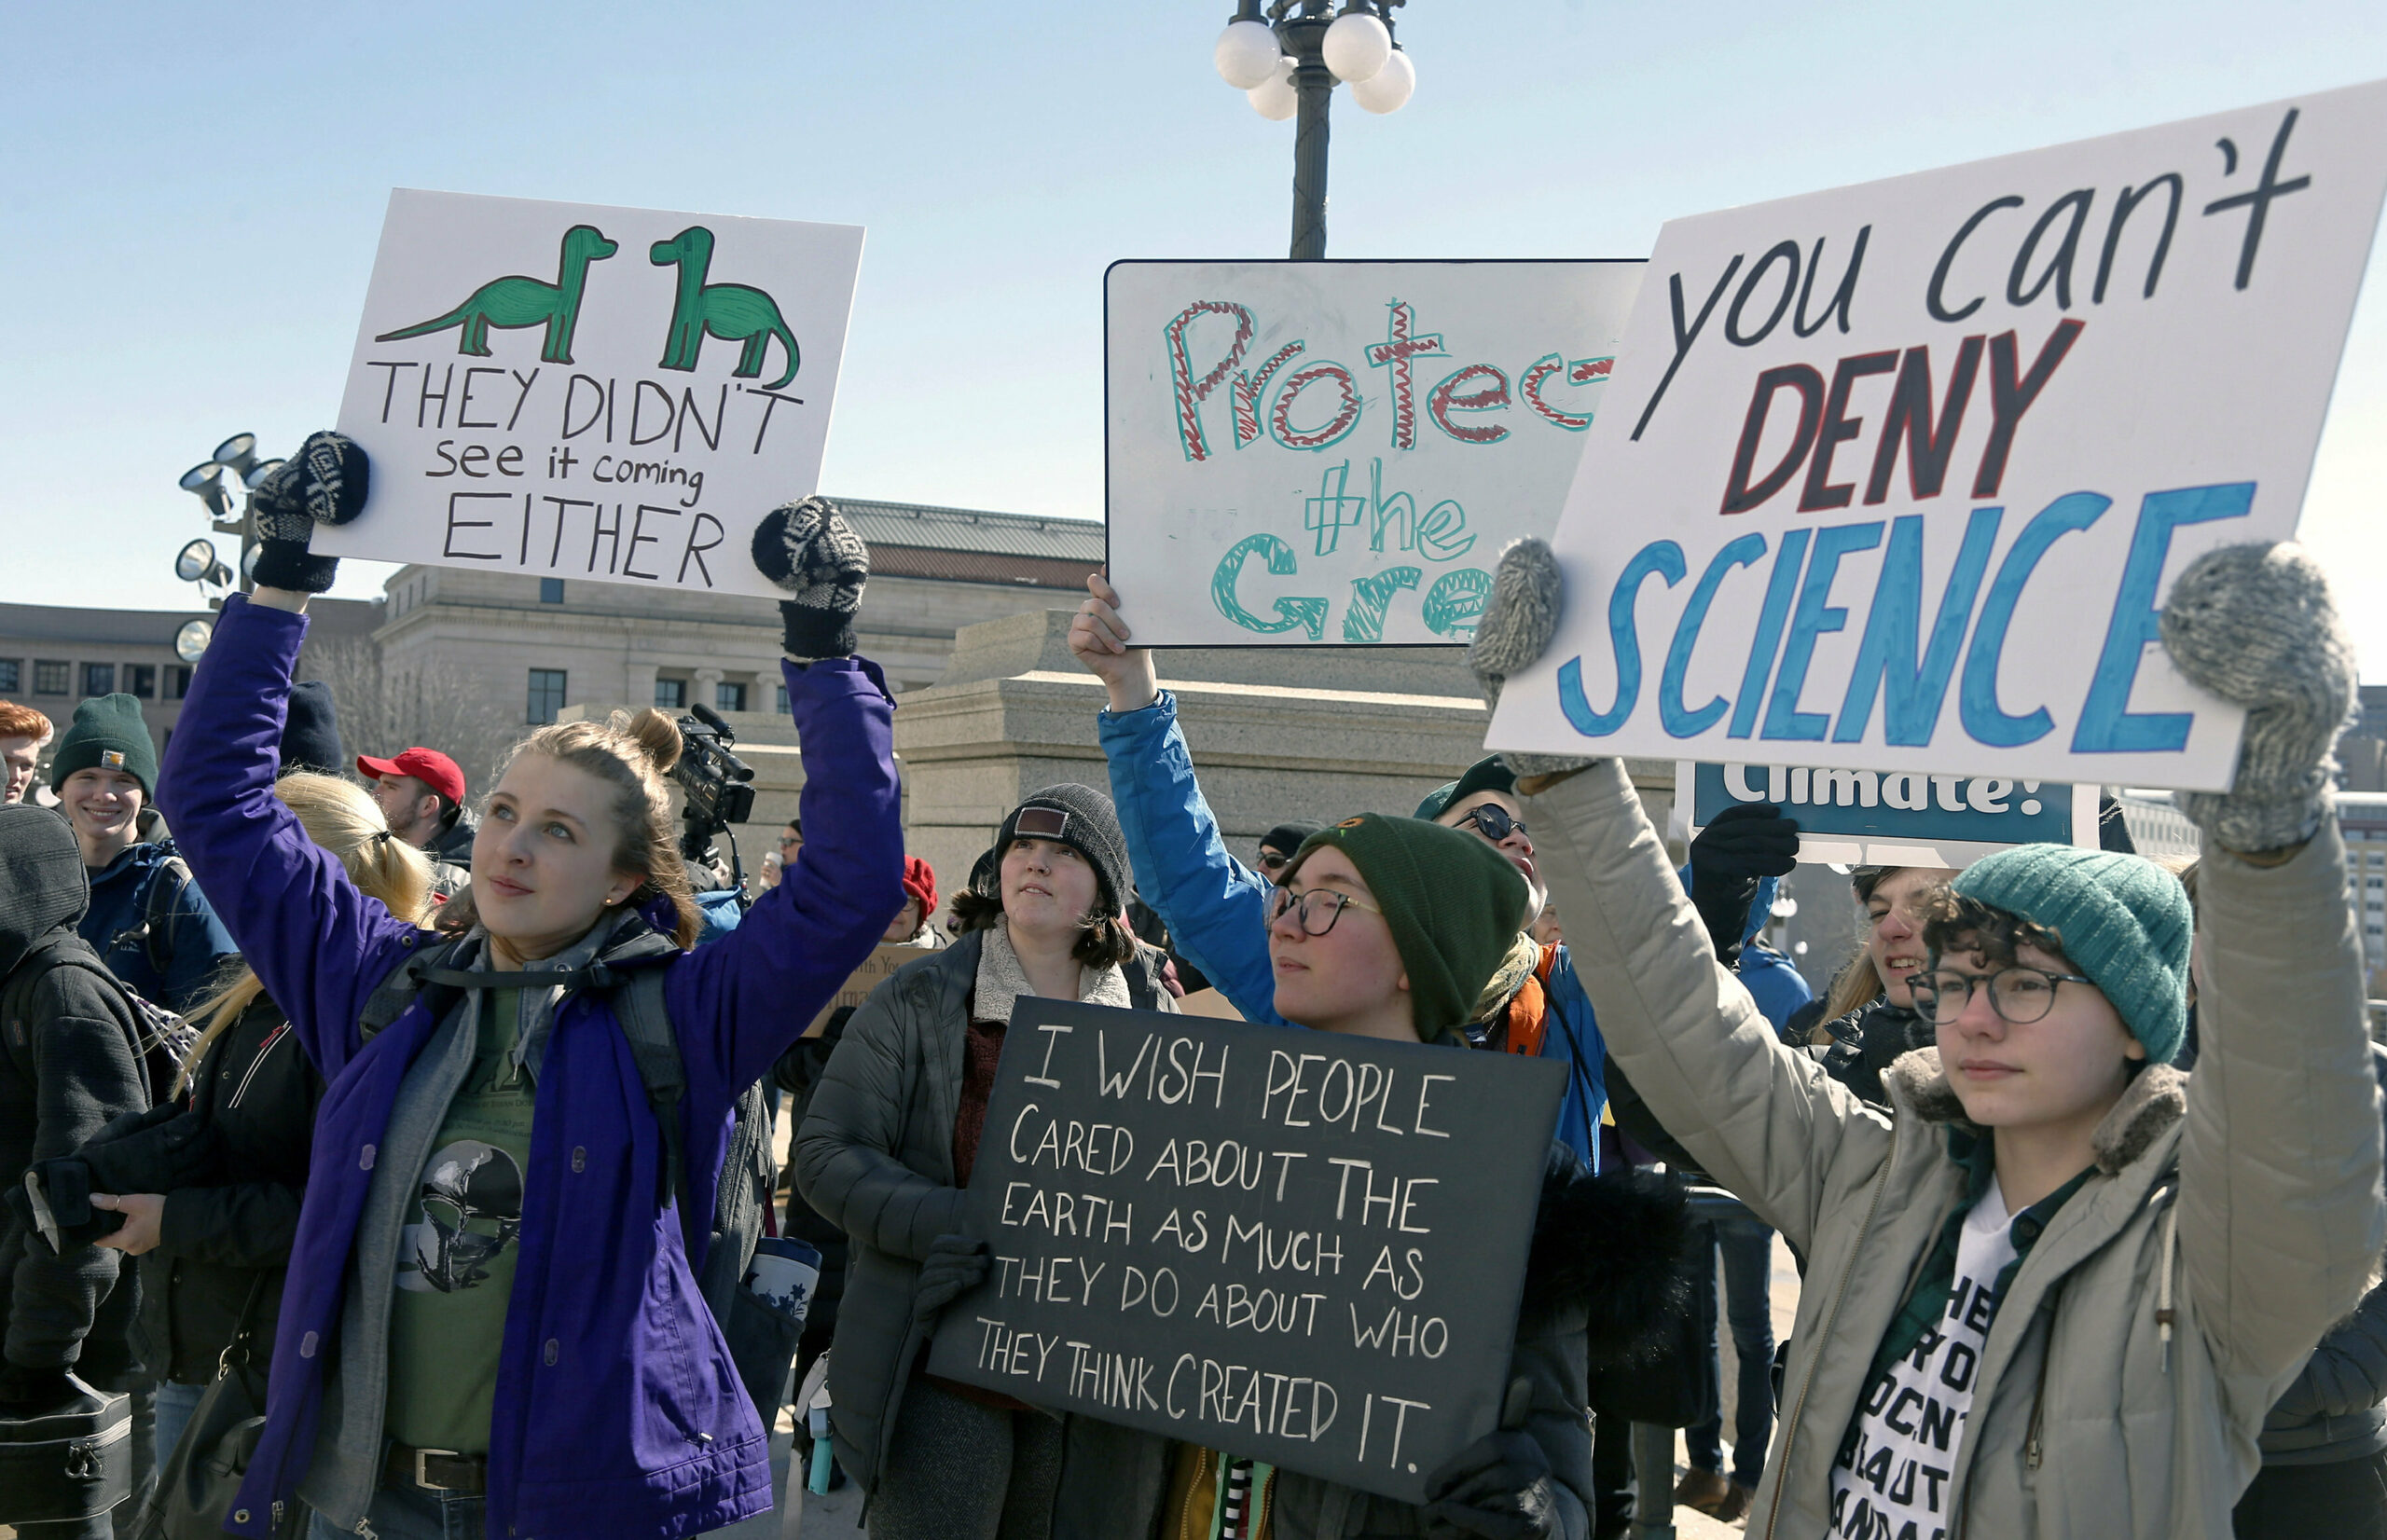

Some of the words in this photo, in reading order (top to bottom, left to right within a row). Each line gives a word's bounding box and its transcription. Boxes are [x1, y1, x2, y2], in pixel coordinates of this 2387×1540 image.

[1631, 225, 1871, 441] you
[1926, 108, 2311, 323] can't
[366, 361, 540, 431] THEY
[561, 374, 804, 454] DIDN'T
[1164, 297, 1615, 461] Protec
[1719, 319, 2086, 515] DENY
[425, 440, 523, 477] see
[548, 447, 579, 479] it
[593, 454, 704, 507] coming
[1305, 457, 1477, 562] the
[443, 492, 724, 587] EITHER
[1557, 481, 2257, 753] SCIENCE
[1024, 1024, 1072, 1089] I
[1098, 1029, 1229, 1108] WISH
[1262, 1051, 1456, 1138] PEOPLE
[1010, 1104, 1134, 1176] CARED
[1146, 1139, 1307, 1202] ABOUT
[1328, 1157, 1439, 1234] THE
[1000, 1182, 1131, 1245] EARTH
[1152, 1209, 1207, 1253] AS
[1221, 1215, 1344, 1276] MUCH
[1363, 1245, 1424, 1300] AS
[995, 1256, 1105, 1306] THEY
[1121, 1264, 1179, 1317] DO
[1195, 1283, 1327, 1337] ABOUT
[1350, 1302, 1449, 1360] WHO
[976, 1316, 1058, 1382] THEY
[1066, 1341, 1159, 1411] THINK
[1167, 1353, 1338, 1443] CREATED
[1358, 1393, 1431, 1475] IT.
